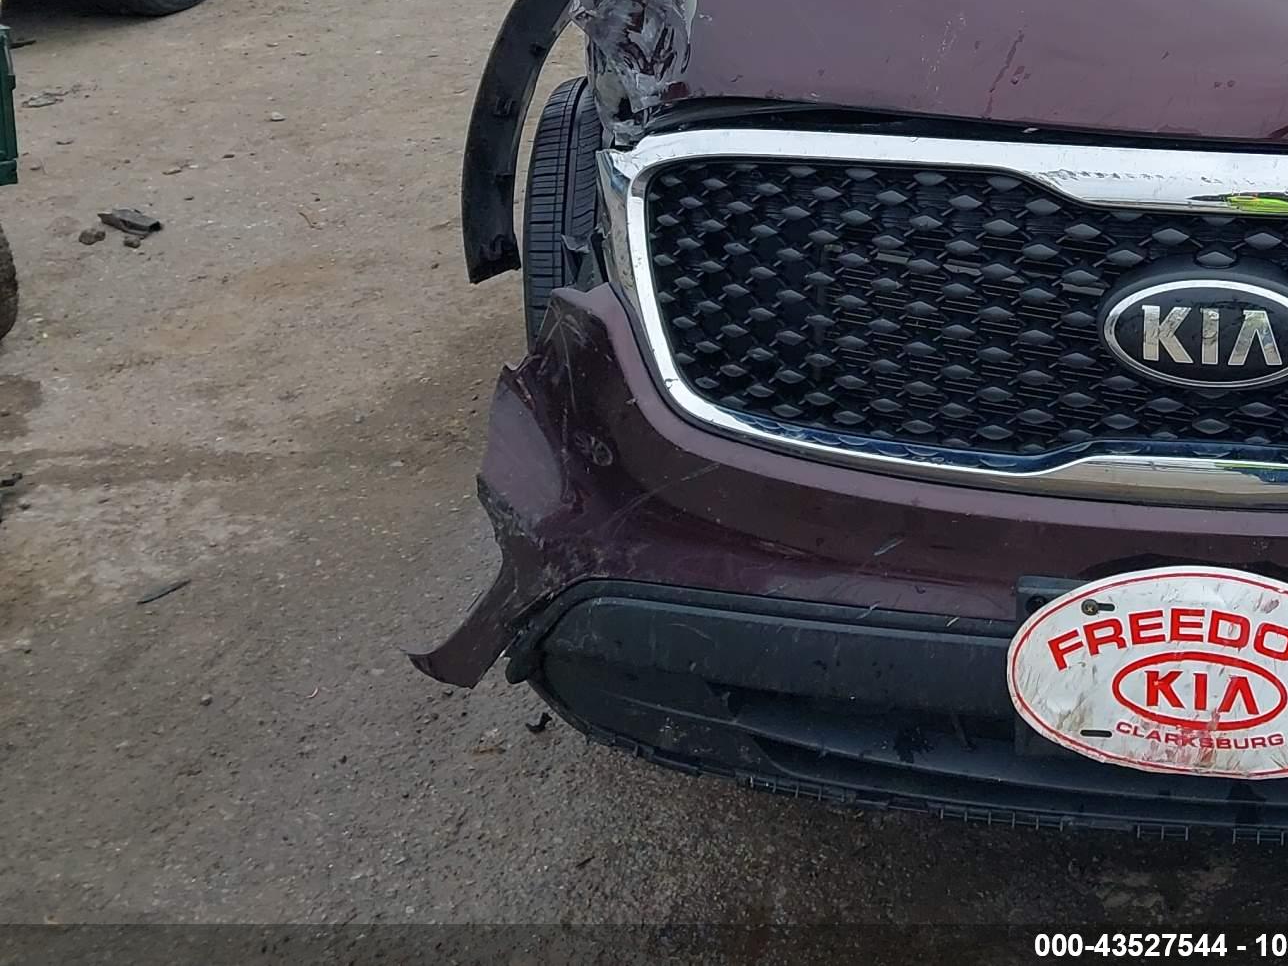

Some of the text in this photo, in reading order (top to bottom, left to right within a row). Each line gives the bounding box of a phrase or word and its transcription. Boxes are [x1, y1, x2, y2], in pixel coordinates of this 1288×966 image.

[1141, 304, 1283, 366] KIA
[1145, 670, 1260, 715] KIA
[1115, 720, 1286, 751] CLARKSBURG
